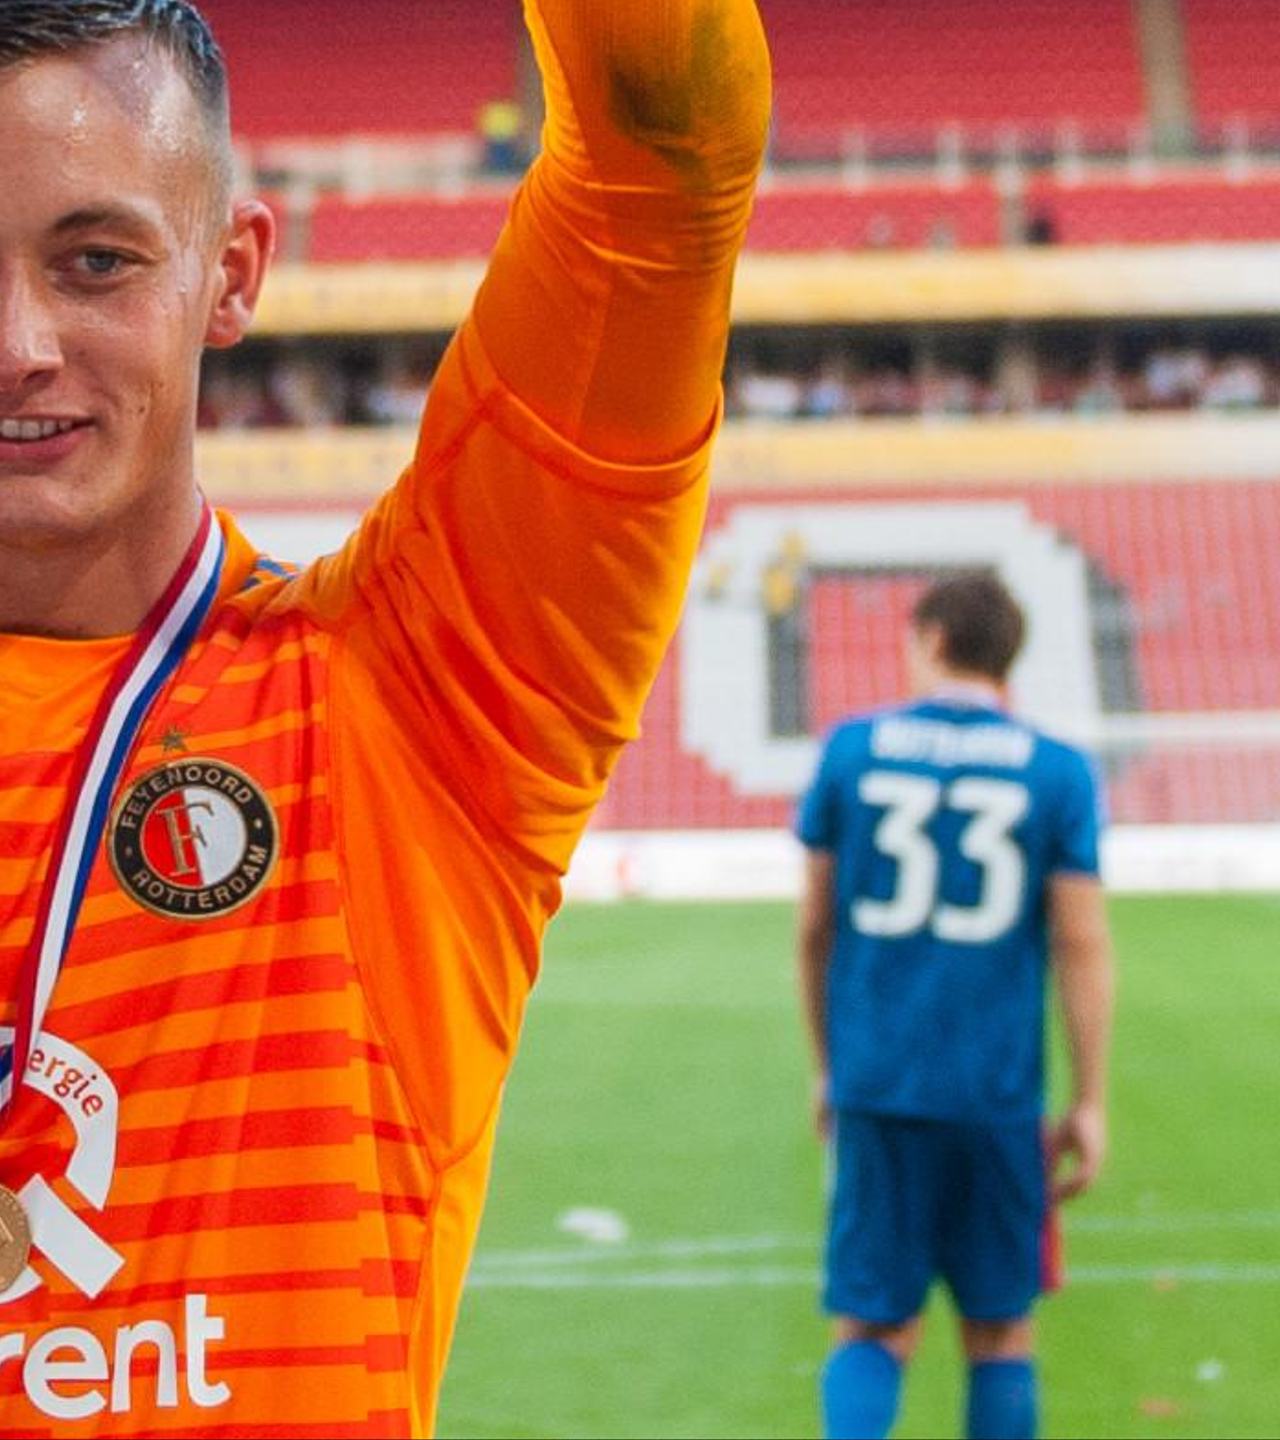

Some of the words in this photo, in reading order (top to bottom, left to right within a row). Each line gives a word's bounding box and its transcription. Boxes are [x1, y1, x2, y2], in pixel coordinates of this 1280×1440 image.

[120, 765, 254, 830] FEYENOORD
[131, 844, 269, 909] ROTTERDAM
[851, 770, 1031, 944] 33
